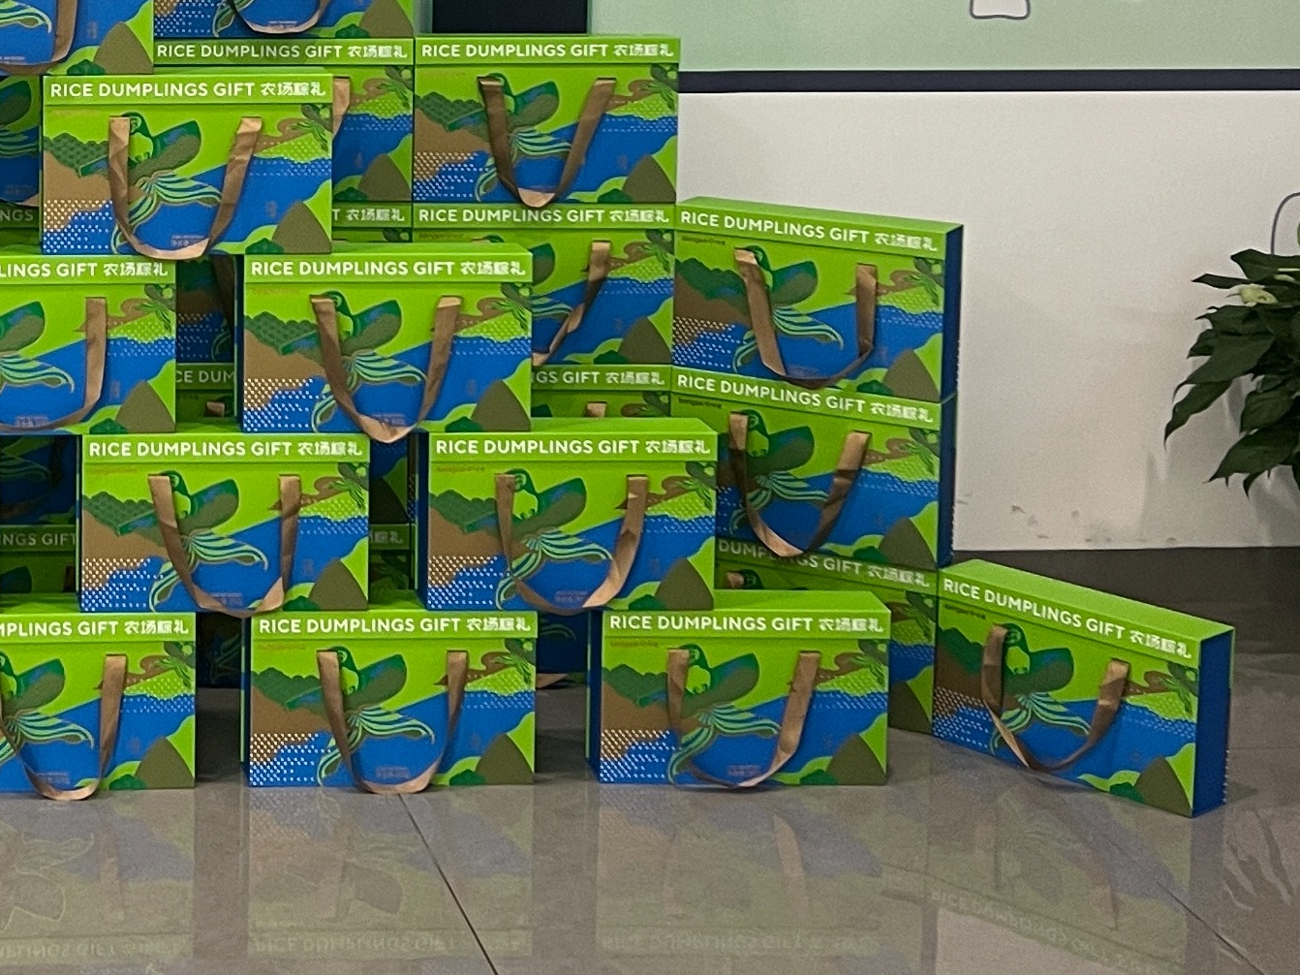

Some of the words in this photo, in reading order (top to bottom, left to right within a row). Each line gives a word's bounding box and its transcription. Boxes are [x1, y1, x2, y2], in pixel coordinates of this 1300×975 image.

[421, 44, 461, 58] RICE
[465, 43, 566, 58] DUMPLINGS
[570, 43, 609, 57] GIFT
[50, 82, 94, 98] RICE
[98, 82, 209, 98] DUMPLINGS
[213, 82, 255, 97] GIFT
[680, 210, 719, 227] RICE
[723, 215, 825, 240] DUMPLINGS
[829, 227, 870, 244] GIFT
[55, 262, 98, 278] GIFT
[435, 439, 479, 455] RICE
[483, 439, 594, 455] DUMPLINGS
[597, 439, 640, 454] GIFT
[943, 578, 980, 600] RICE
[984, 589, 1082, 628] DUMPLINGS
[1085, 617, 1126, 639] GIFT
[77, 620, 119, 636] GIFT
[609, 614, 653, 630] RICE
[657, 615, 767, 631] DUMPLINGS
[771, 616, 814, 632] GIFT
